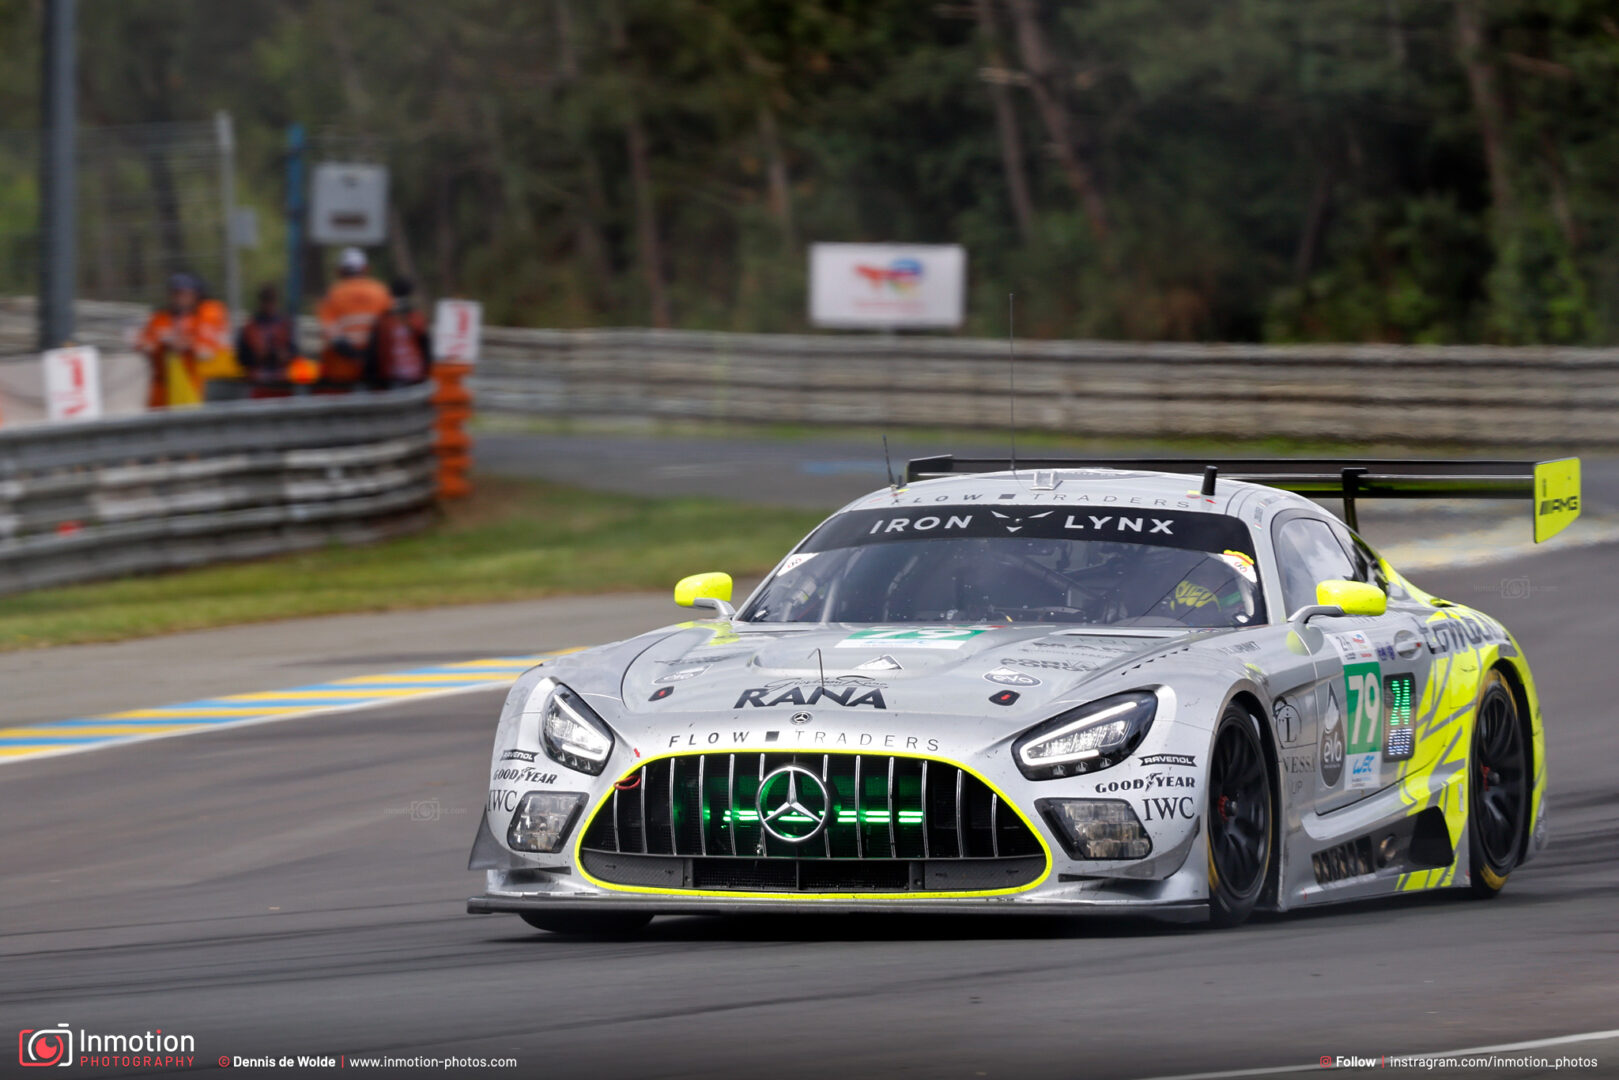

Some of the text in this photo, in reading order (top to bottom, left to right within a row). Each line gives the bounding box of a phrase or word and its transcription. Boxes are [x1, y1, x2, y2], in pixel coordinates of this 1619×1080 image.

[1032, 493, 1190, 509] TRADERS
[869, 515, 973, 534] IRON
[1063, 515, 1175, 535] LYNX
[733, 686, 888, 710] RANA
[1348, 673, 1380, 745] 79
[668, 730, 940, 752] FLOW TRADERS
[1142, 755, 1194, 765] RAVENOL
[487, 789, 518, 812] IWC
[1141, 796, 1196, 821] IWC
